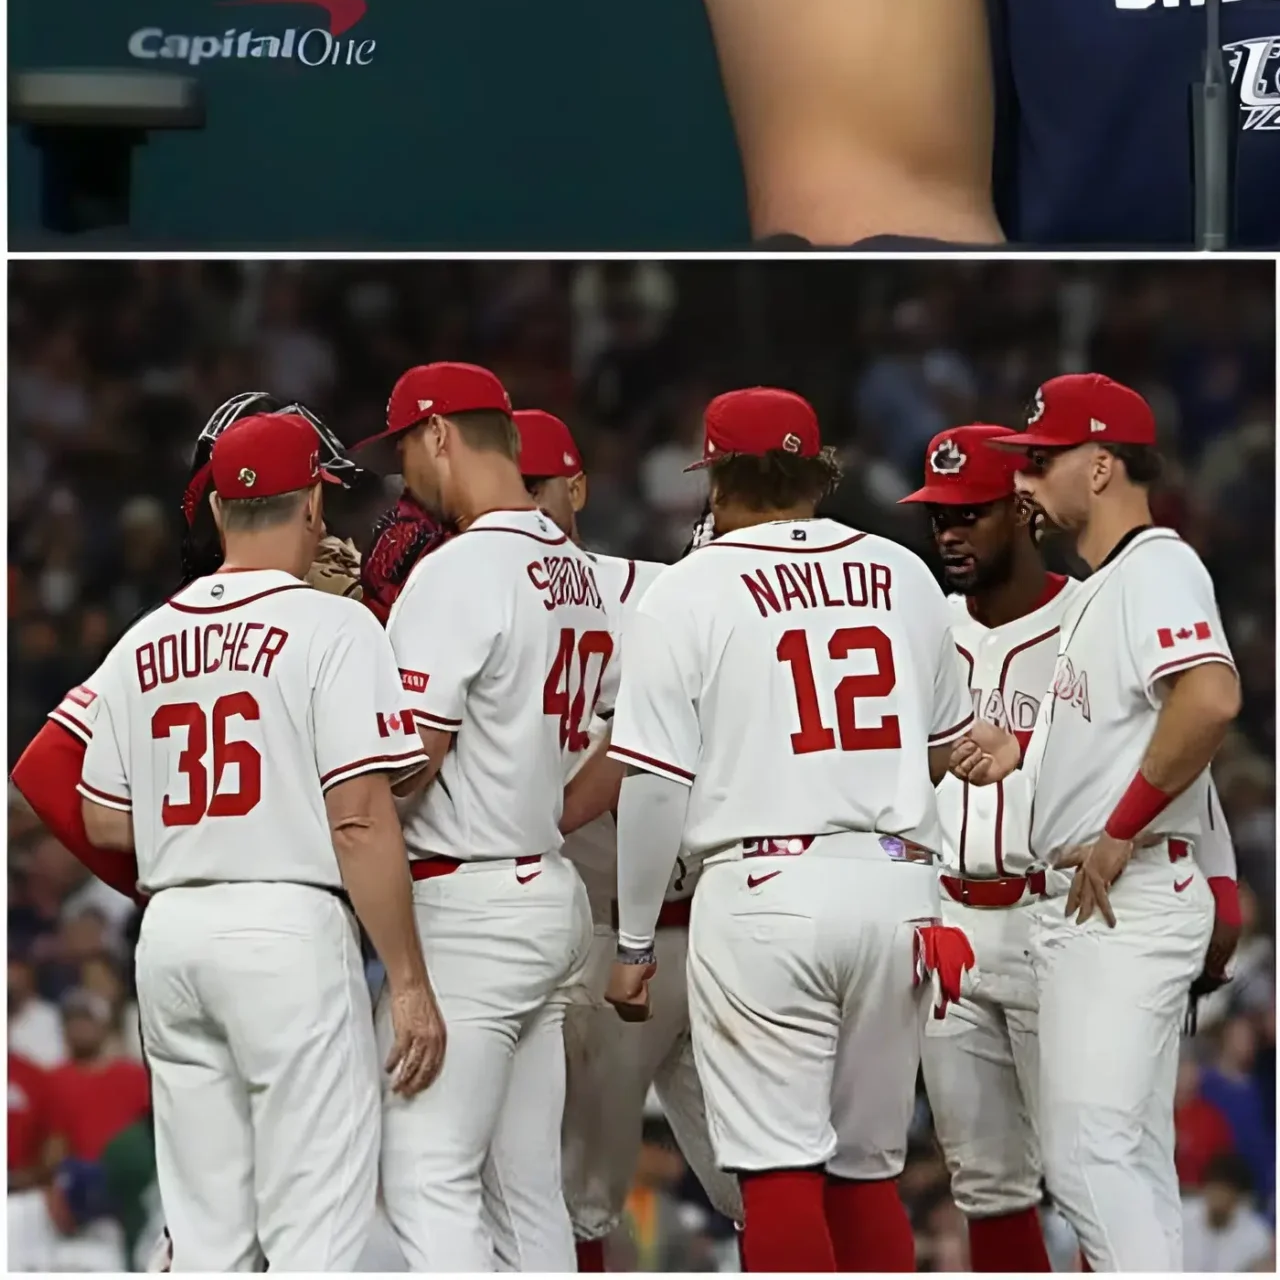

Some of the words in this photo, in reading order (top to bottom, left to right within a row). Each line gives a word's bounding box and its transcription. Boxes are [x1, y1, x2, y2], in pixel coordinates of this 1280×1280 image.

[740, 561, 893, 617] NAYLOR
[135, 622, 289, 694] BOUCHER
[543, 627, 614, 754] 40
[776, 625, 902, 756] 12
[151, 691, 261, 827] 36
